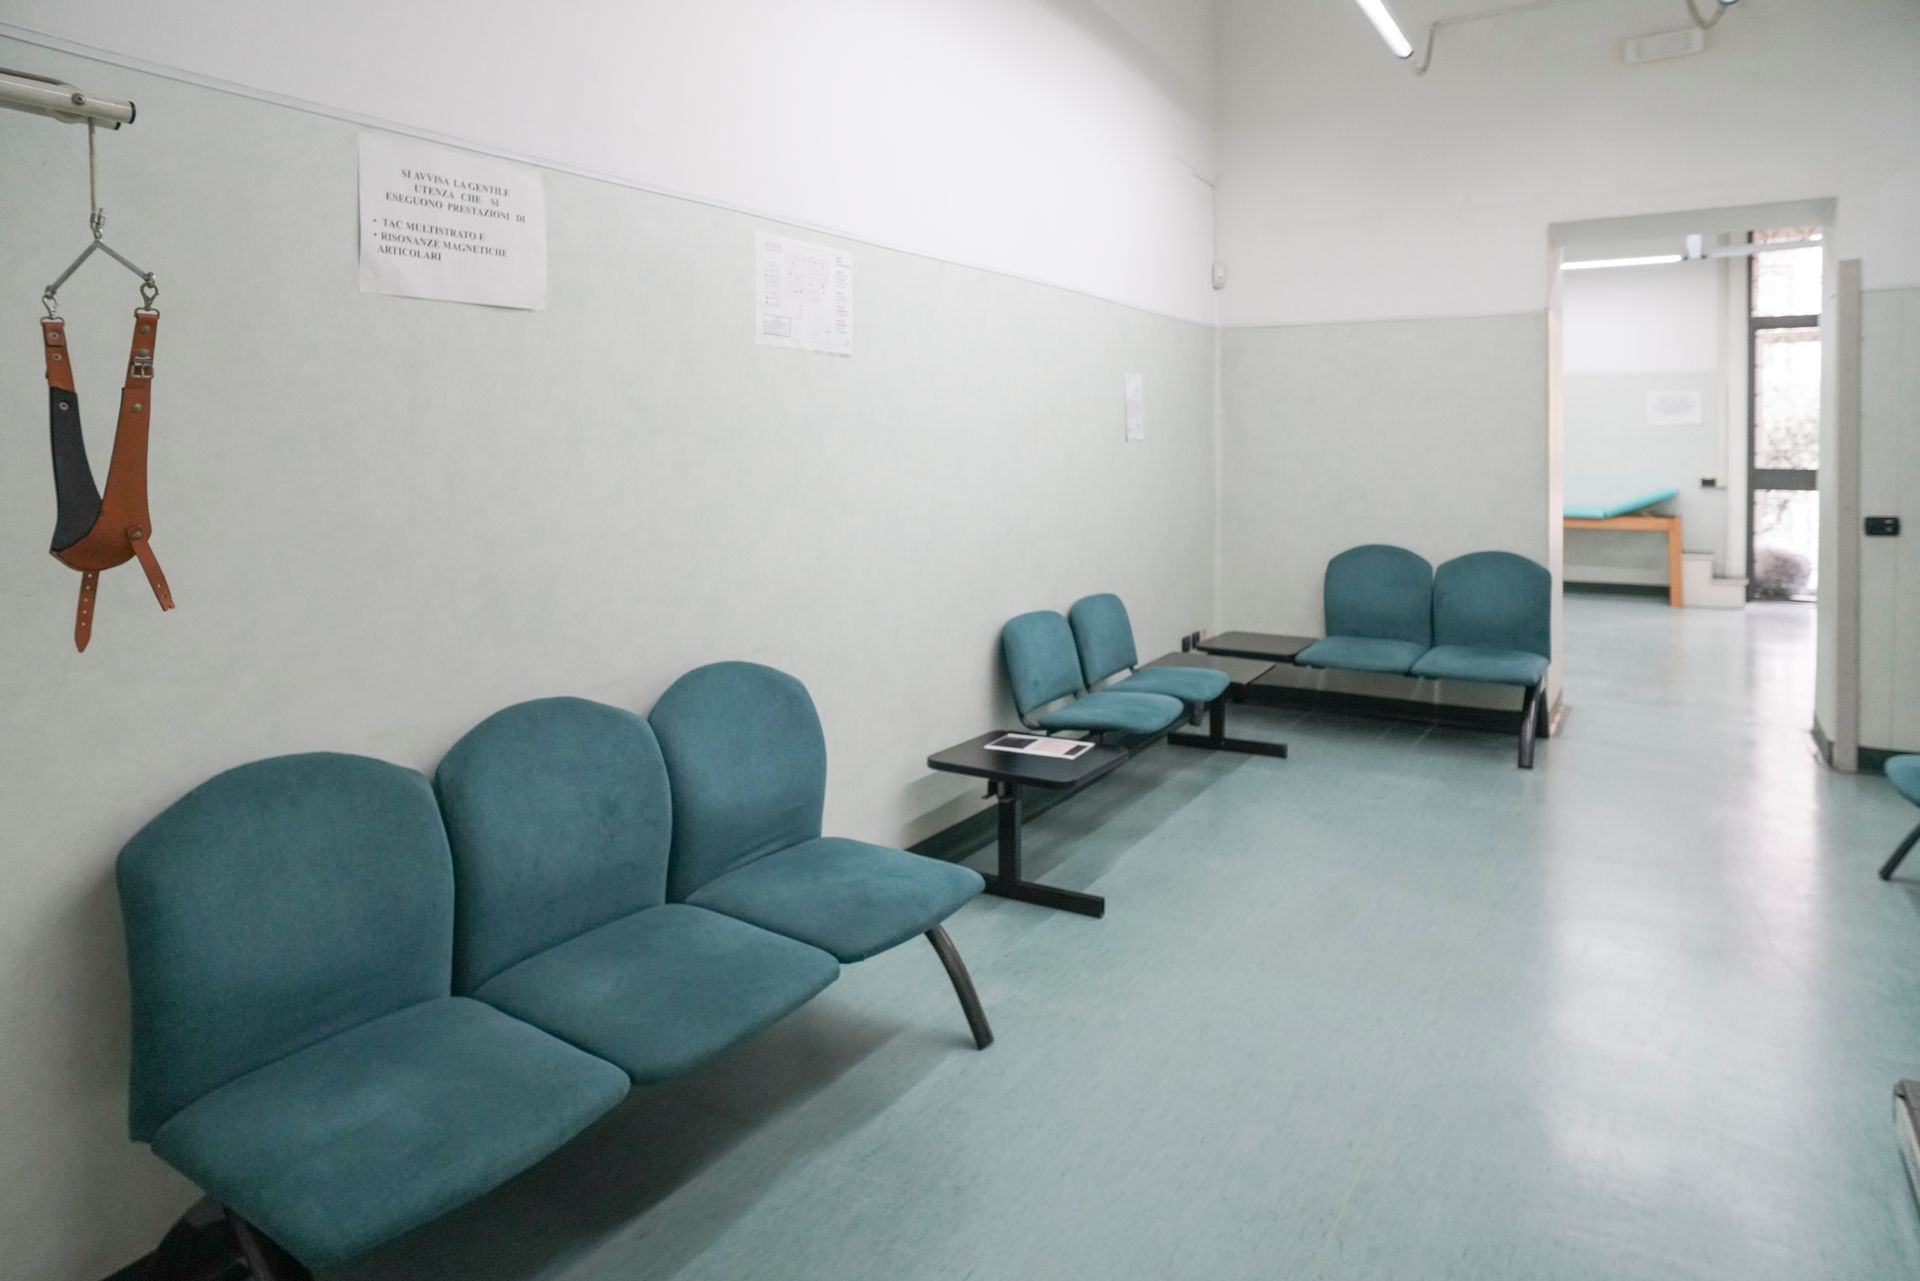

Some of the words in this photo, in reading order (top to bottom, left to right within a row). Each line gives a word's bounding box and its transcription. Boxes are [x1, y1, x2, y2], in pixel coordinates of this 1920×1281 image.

[401, 169, 411, 178] SI
[413, 172, 449, 186] AVVISA
[453, 179, 466, 189] LA
[467, 182, 509, 197] GENTILE
[385, 191, 443, 209] ESEGUONO
[447, 202, 510, 220] PRESTAZIONI
[516, 214, 526, 223] DI
[414, 184, 455, 199] UTENZA
[460, 193, 481, 204] CHE
[490, 198, 499, 207] SI
[382, 218, 404, 230] TAC
[405, 222, 477, 240] MULTISTRATO
[479, 233, 486, 241] E
[377, 244, 442, 261] ARTICOLARI
[380, 232, 440, 248] RISONANZE
[443, 241, 508, 257] MAGNETICHE
